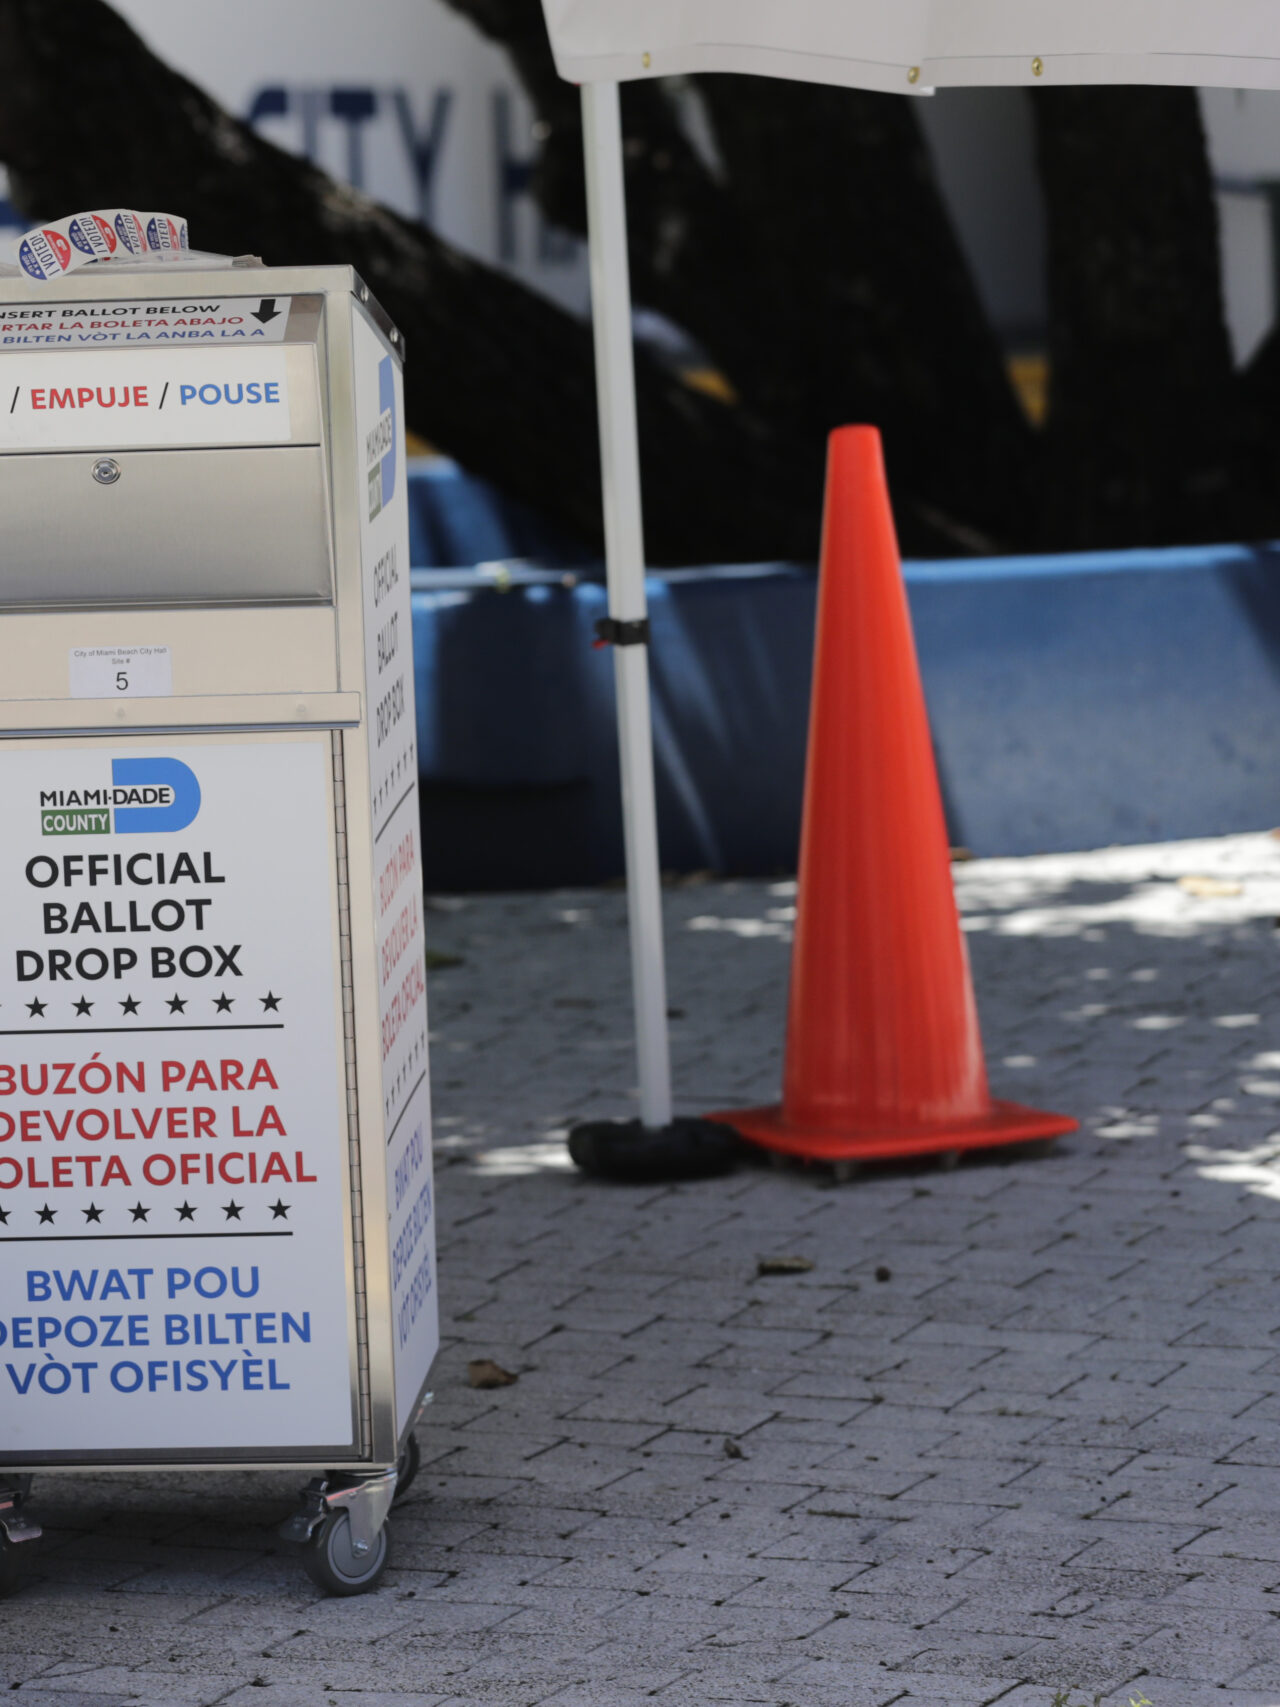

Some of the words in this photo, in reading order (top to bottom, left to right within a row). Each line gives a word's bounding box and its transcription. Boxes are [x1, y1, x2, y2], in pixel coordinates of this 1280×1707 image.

[79, 217, 104, 248] VOTED!
[157, 218, 170, 249] OTED!
[29, 233, 57, 269] VOTED!
[59, 320, 85, 331] LA
[90, 318, 169, 329] BOLETA
[173, 316, 244, 326] ABAJO
[61, 307, 142, 317] BALLOT
[145, 304, 220, 314] BELOW
[3, 333, 72, 344] BILTEN
[77, 331, 124, 342] VÒT
[126, 331, 151, 340] LA
[154, 330, 214, 340] ANBA
[220, 328, 248, 338] LA
[250, 327, 265, 336] A
[10, 386, 20, 413] /
[30, 385, 148, 410] EMPUJE
[159, 382, 169, 410] /
[180, 382, 280, 406] POUSE
[74, 650, 87, 658] City
[117, 648, 138, 656] Beach
[139, 648, 152, 656] City
[116, 671, 129, 691] 5
[43, 813, 108, 832] COUNTY
[25, 851, 226, 888] OFFICIAL
[43, 898, 212, 934] BALLOT
[16, 947, 138, 982] DROP
[151, 944, 244, 978] BOX
[161, 1058, 279, 1092] PARA
[231, 1105, 288, 1137] LA
[142, 1151, 318, 1186] OFICIAL
[26, 1268, 154, 1302] BWAT
[167, 1266, 260, 1299] POU
[164, 1311, 311, 1346] BILTEN
[5, 1353, 98, 1395] VÒT
[110, 1349, 290, 1394] OFISYÈL
